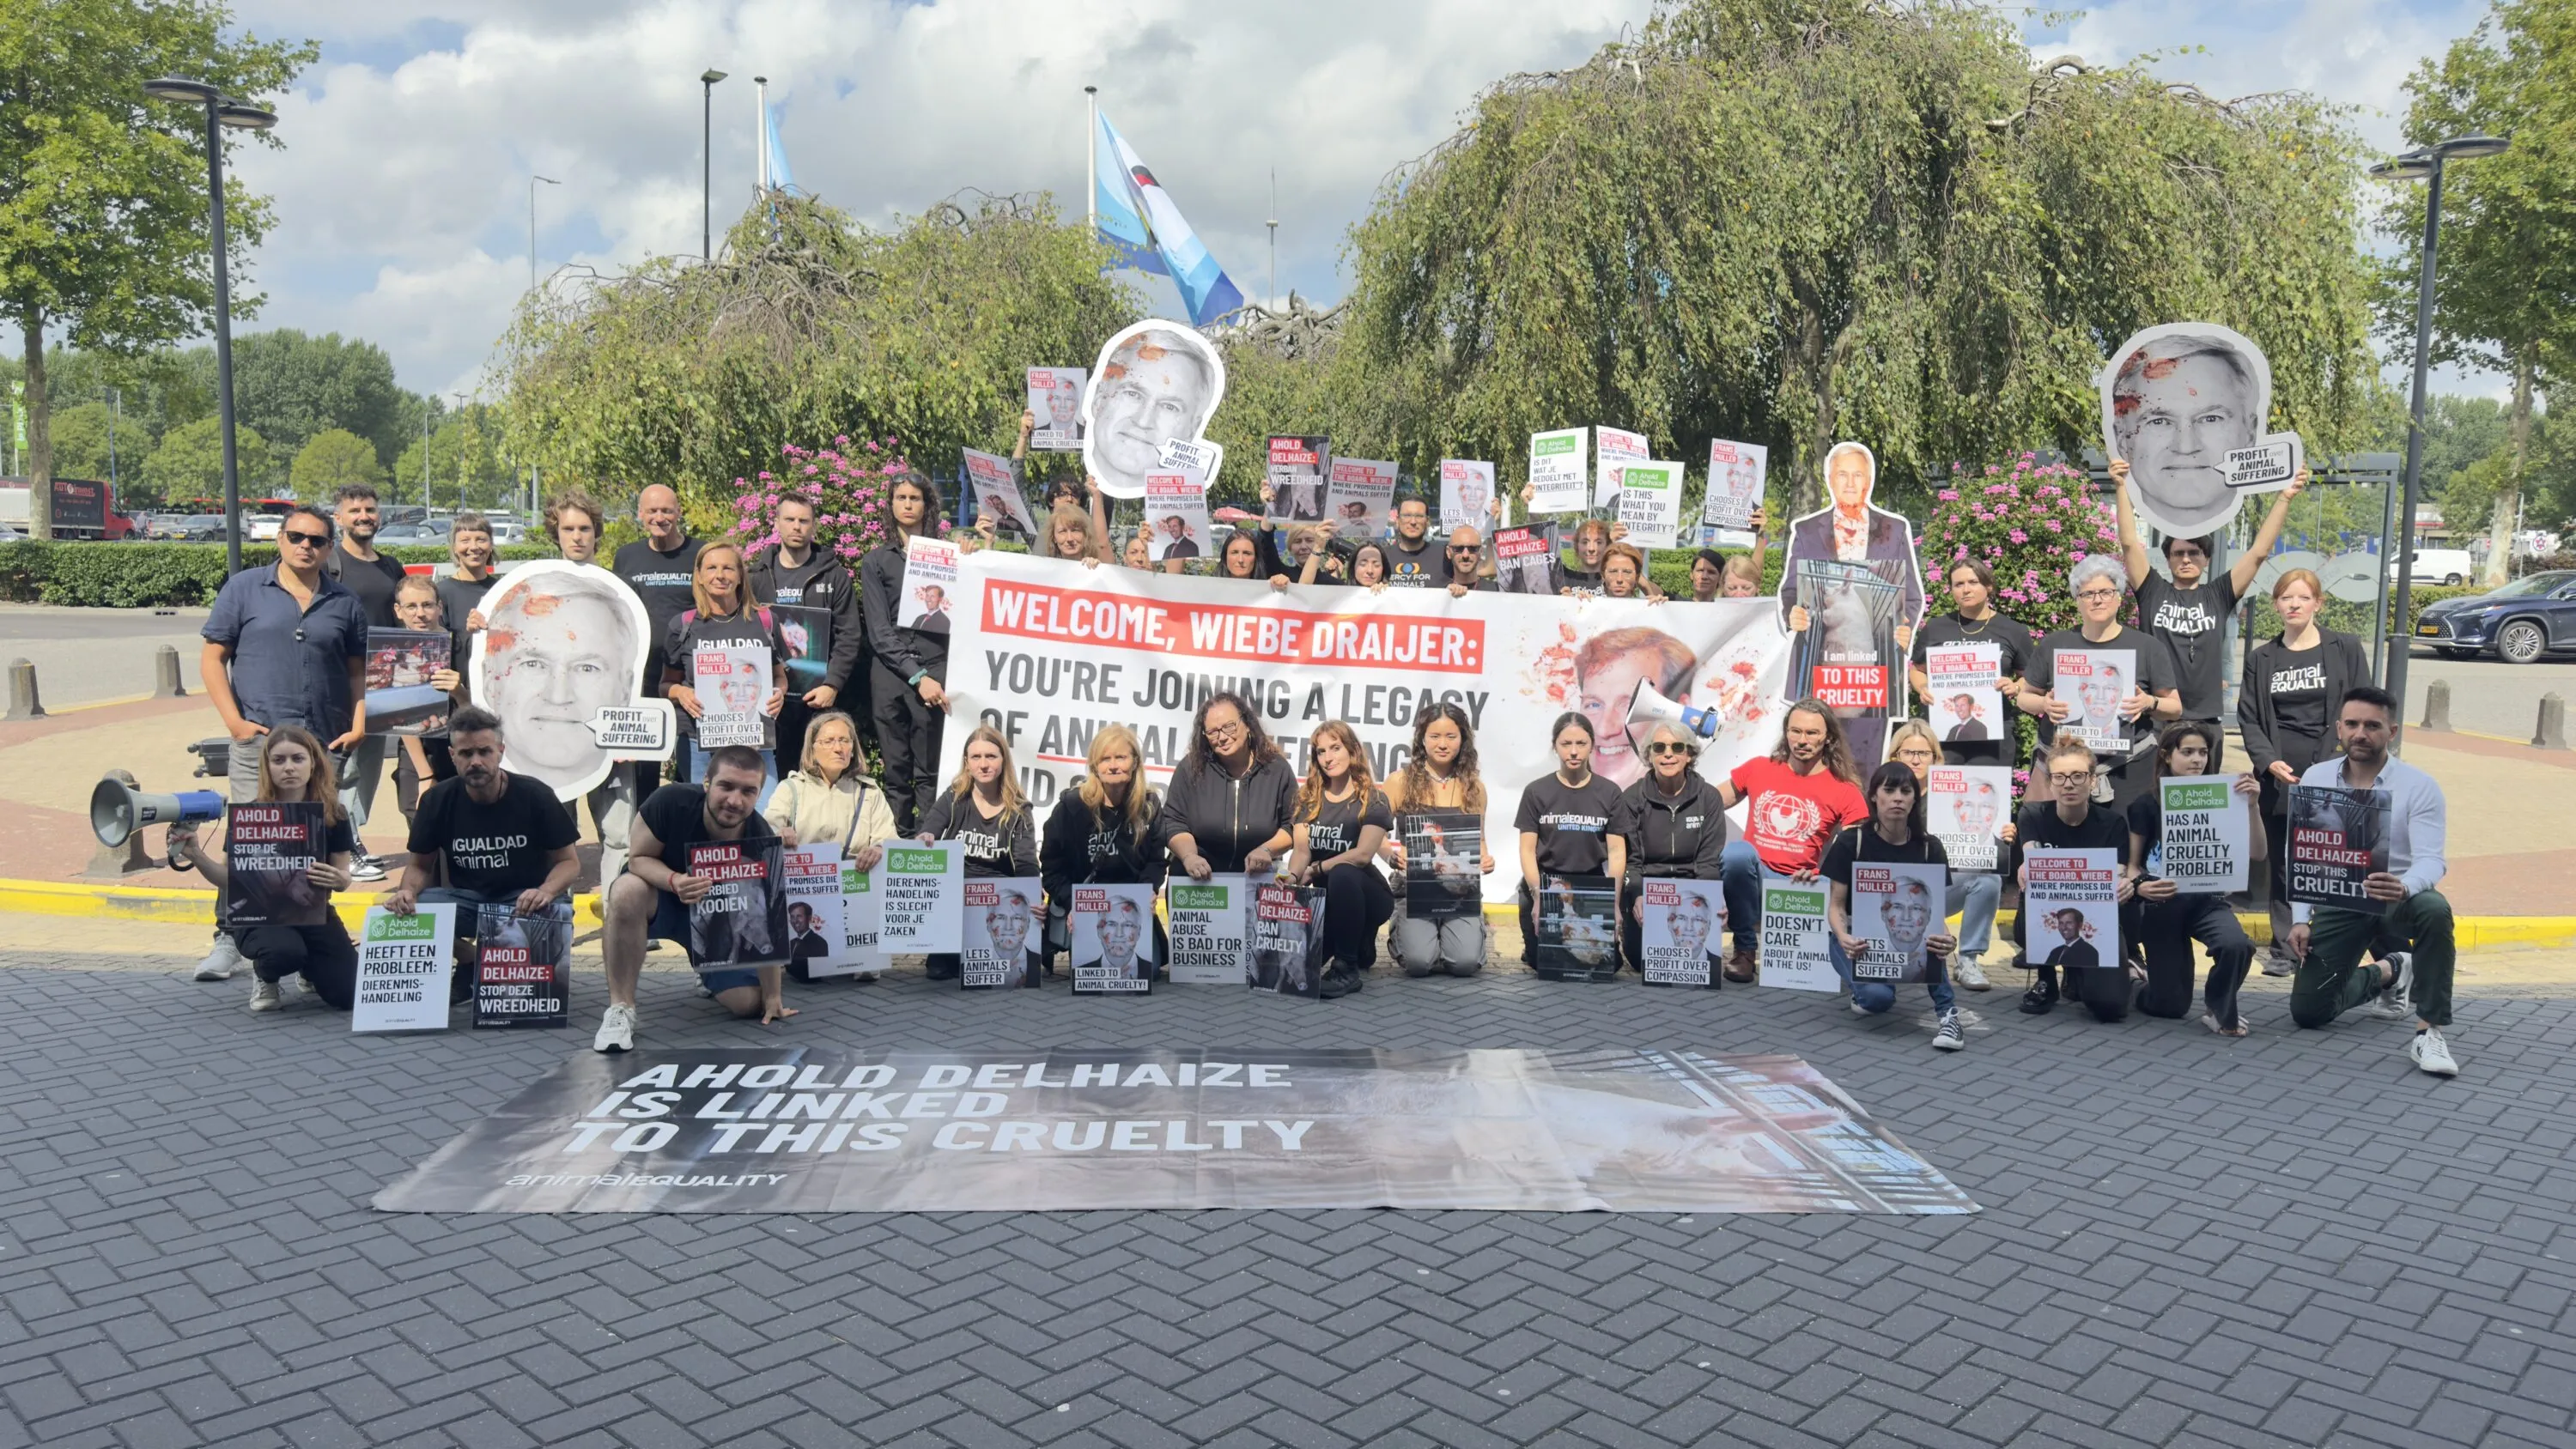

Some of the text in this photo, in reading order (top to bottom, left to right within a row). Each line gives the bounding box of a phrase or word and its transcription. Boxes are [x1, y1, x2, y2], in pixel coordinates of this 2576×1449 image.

[1272, 440, 1301, 451] AHOLD
[1272, 452, 1315, 463] DELHAIZE:
[2230, 449, 2268, 462] PROFIT
[2239, 458, 2275, 471] ANIMAL
[2232, 466, 2285, 482] SUFFERING
[1271, 475, 1323, 486] WREEDHEID
[1638, 478, 1665, 487] Delhaize
[1623, 489, 1652, 500] IS THIS
[1622, 500, 1666, 511] WHAT YOU
[1621, 511, 1658, 521] MEAN BY
[1498, 530, 1528, 543] AHOLD
[1499, 541, 1546, 555] DELHAIZE:
[1498, 553, 1556, 571] BAN CAGES
[2159, 600, 2204, 618] animal
[991, 587, 1477, 666] WELCOME, WIEBE DRAIJER:
[2154, 613, 2216, 634] EQUALITY
[1848, 650, 1878, 662] linked
[1821, 668, 1880, 685] TO THIS
[2271, 663, 2319, 682] animal
[986, 650, 1122, 705] YOU'RE
[1303, 682, 1326, 721] A
[2271, 676, 2326, 694] EQUALIT
[1816, 688, 1883, 706] CRUELTY
[603, 711, 642, 721] PROFIT
[702, 713, 744, 722] CHOOSES
[610, 723, 648, 733] ANIMAL
[702, 724, 762, 734] PROFIT OVER
[602, 733, 657, 743] SUFFERING
[702, 736, 760, 745] COMPASSION
[2186, 789, 2212, 797] Ahold
[2185, 797, 2225, 806] Delhaize
[236, 809, 280, 822] AHOLD
[2166, 814, 2208, 826] HAS AN
[236, 827, 304, 839] DELHAIZE:
[955, 830, 999, 848] animal
[2166, 828, 2221, 843] ANIMAL
[2297, 831, 2342, 845] AHOLD
[234, 844, 276, 854] STOP DE
[453, 835, 527, 852] IGUALDAD
[695, 847, 738, 864] AHOLD
[2166, 845, 2230, 859] CRUELTY
[2297, 848, 2366, 864] DELHAIZE:
[453, 852, 508, 869] animal
[908, 854, 933, 863] Ahold
[2030, 859, 2084, 868] WELCOME TO
[696, 863, 764, 880] DELHAIZE:
[907, 862, 944, 870] Delhaize
[2166, 861, 2233, 876] PROBLEM
[2293, 863, 2348, 877] STOP THIS
[1858, 870, 1887, 879] FRANS
[2030, 871, 2046, 880] THE
[2081, 871, 2111, 880] WIEBE:
[886, 877, 941, 887] DIERENMIS-
[1857, 882, 1894, 892] MULLER
[2293, 876, 2368, 899] CRUELTY
[886, 889, 939, 899] HANDELING
[966, 885, 993, 894] FRANS
[1648, 884, 1674, 893] FRANS
[966, 896, 998, 905] MULLER
[1261, 888, 1292, 903] AHOLD
[1648, 896, 1679, 905] MULLER
[1785, 894, 1810, 904] Ahold
[696, 896, 748, 914] KOOIEN
[885, 901, 933, 911] IS SLECHT
[1077, 902, 1109, 911] MULLER
[1784, 902, 1820, 912] Delhaize
[885, 914, 925, 923] VOOR JE
[1172, 912, 1210, 922] ANIMAL
[1260, 906, 1309, 921] DELHAIZE:
[389, 919, 418, 927] Ahold
[1257, 921, 1279, 935] BAN
[1766, 916, 1824, 931] DOESN'T
[388, 927, 430, 937] Delhaize
[884, 926, 915, 936] ZAKEN
[1172, 925, 1206, 935] ABUSE
[1172, 937, 1242, 950] IS BAD FOR
[1765, 931, 1801, 946] CARE
[1256, 937, 1302, 954] CRUELTY
[366, 945, 435, 959] HEEFT EEN
[484, 949, 526, 962] AHOLD
[966, 949, 990, 959] LETS
[1647, 947, 1690, 957] CHOOSES
[1765, 949, 1831, 961] ABOUT ANIMAL
[1857, 953, 1905, 963] ANIMALS
[1173, 953, 1236, 965] BUSINESS
[1647, 959, 1708, 970] PROFIT OVER
[364, 961, 437, 975] PROBLEEM:
[965, 961, 1007, 971] ANIMALS
[1777, 960, 1794, 969] THE
[1796, 961, 1811, 971] US!
[1856, 966, 1899, 976] SUFFER
[483, 967, 550, 979] DELHAIZE:
[1646, 971, 1706, 983] COMPASSION
[362, 979, 424, 991] DIERENMIS-
[964, 974, 1002, 985] SUFFER
[1077, 980, 1146, 989] ANIMAL CRUELTY!
[361, 991, 422, 1003] HANDELING
[480, 985, 533, 997] STOP DEZE
[480, 998, 560, 1012] WREEDHEID
[618, 1062, 1292, 1089] AHOLD DELHAIZE
[586, 1092, 1009, 1119] IS LINKED
[562, 1120, 1315, 1153] TO THIS CRUELTY
[504, 1172, 789, 1187] animalEQUALITY
